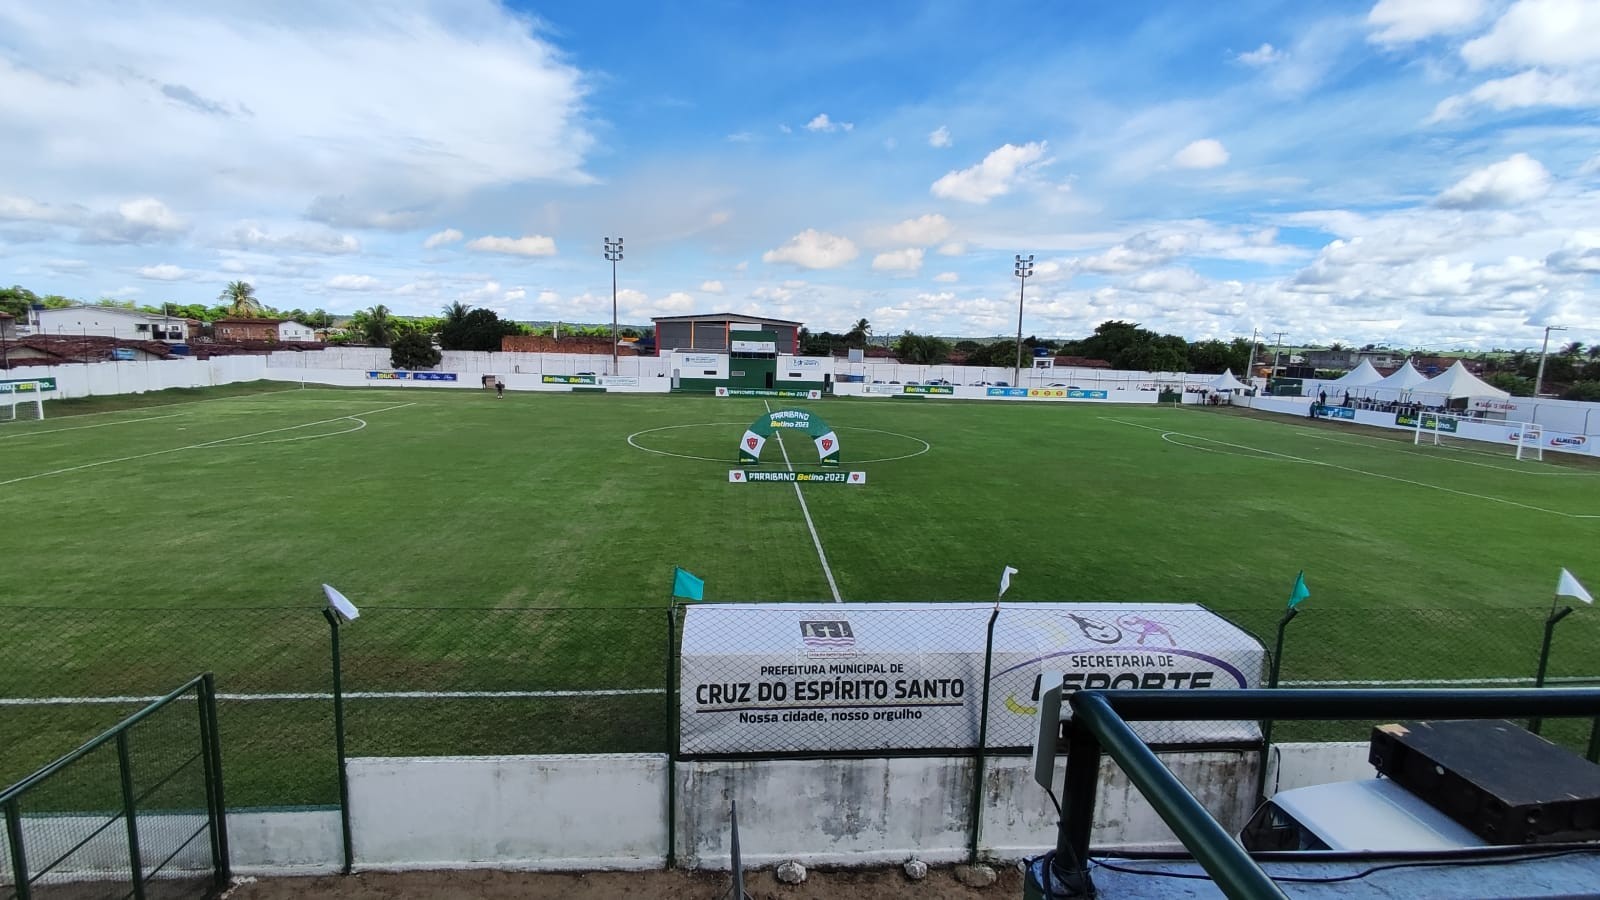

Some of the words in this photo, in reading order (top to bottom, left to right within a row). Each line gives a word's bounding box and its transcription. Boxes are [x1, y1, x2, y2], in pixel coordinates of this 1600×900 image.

[769, 410, 810, 420] PARAIBANO
[1556, 437, 1581, 445] ALMEIDA
[749, 472, 796, 481] PARAIBANO
[796, 473, 824, 481] Betino
[825, 473, 845, 482] 2023
[1072, 655, 1155, 668] SECRETARIA
[1158, 655, 1174, 667] DE
[760, 665, 826, 676] PREFEITURA
[829, 664, 886, 675] MUNICIPAL
[889, 663, 904, 674] DE
[696, 683, 750, 704] CRUZ
[757, 682, 787, 702] DO
[794, 676, 888, 701] ESPÍRITO
[894, 678, 964, 699] SANTO
[739, 711, 778, 724] Nossa
[782, 710, 827, 723] cidade,
[831, 711, 869, 722] nosso
[873, 709, 922, 722] orgulho
